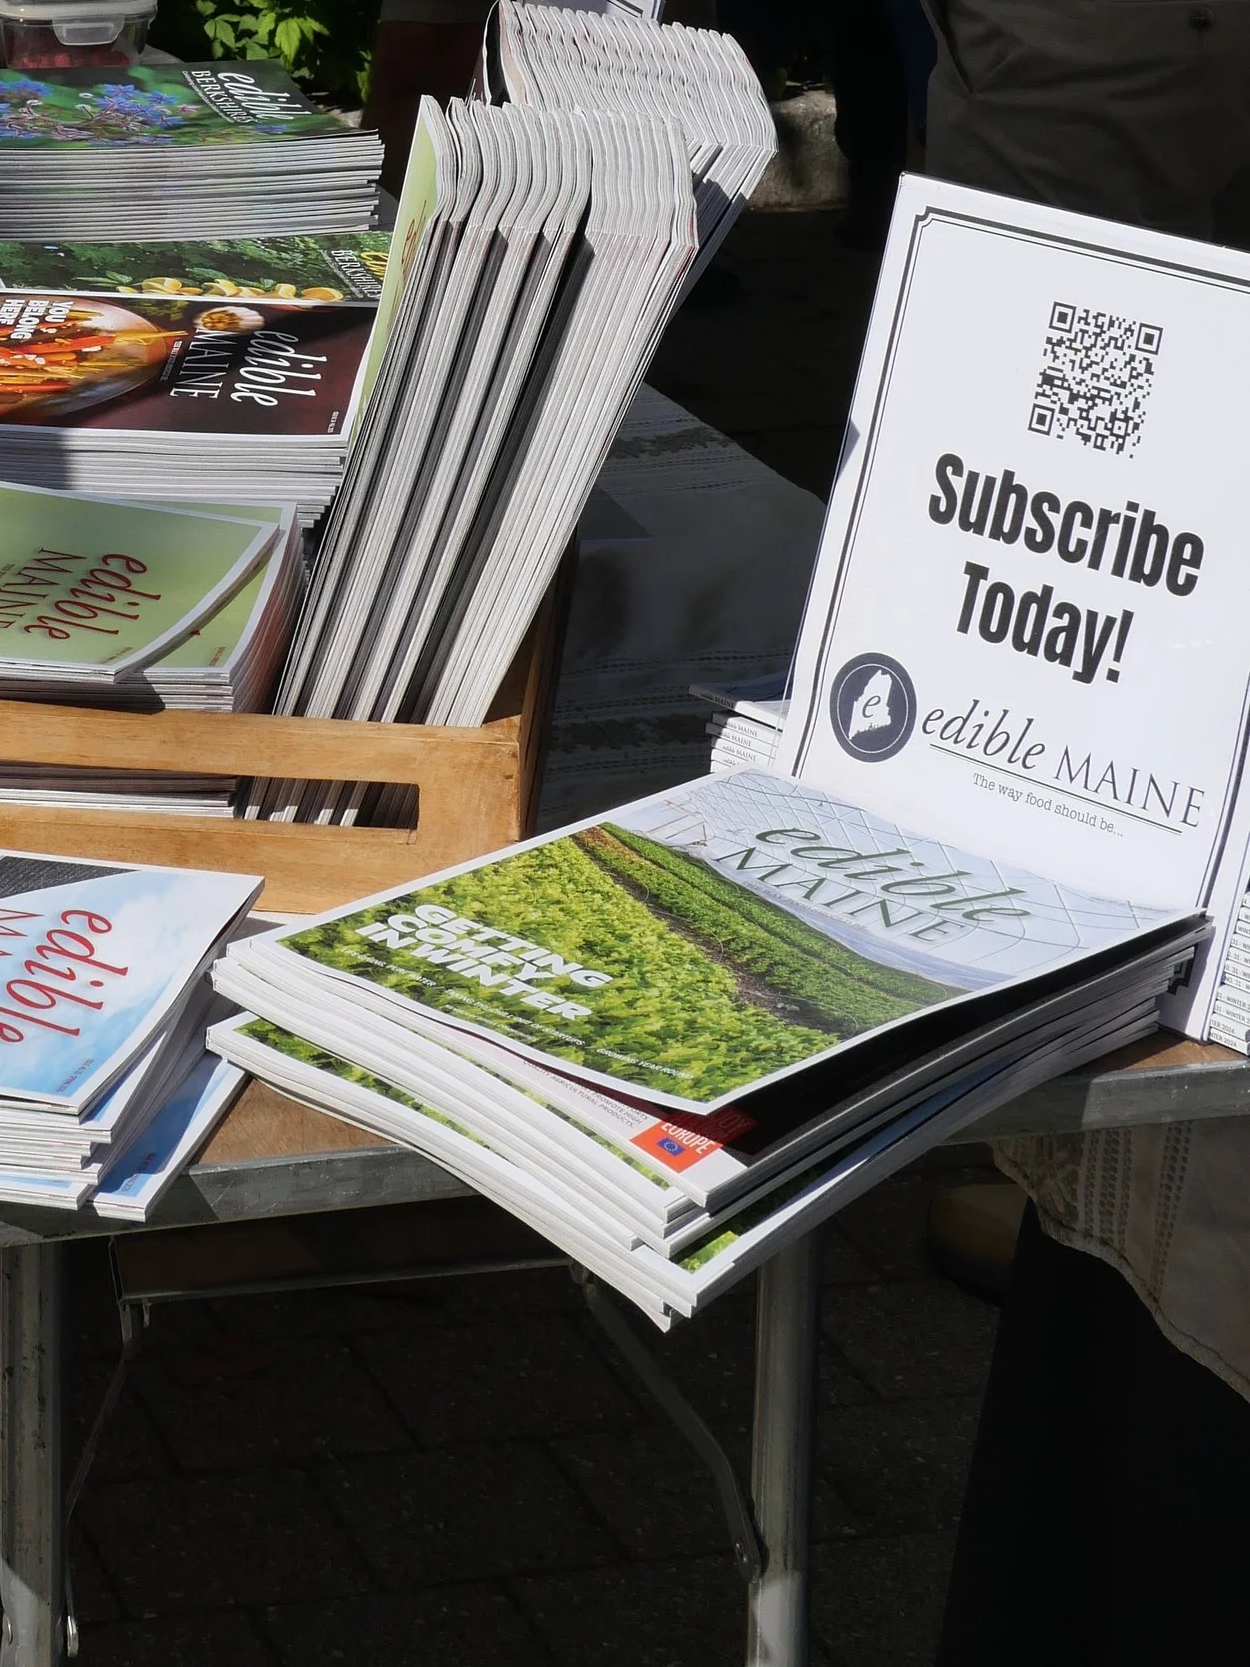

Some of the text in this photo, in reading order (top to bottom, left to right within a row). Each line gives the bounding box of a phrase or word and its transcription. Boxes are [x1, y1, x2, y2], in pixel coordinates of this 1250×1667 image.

[190, 70, 258, 125] BERKSHIRES
[217, 71, 312, 121] edible
[330, 249, 382, 300] BERKSHIRES
[9, 299, 49, 340] BELONG
[52, 300, 76, 323] YOU
[169, 328, 224, 400] MAINE
[230, 331, 328, 408] edible
[928, 453, 1205, 598] Subscribe
[23, 552, 162, 642] edible
[956, 561, 1134, 685] Today!
[715, 697, 735, 709] MAINE
[732, 735, 752, 747] MAINE
[736, 748, 757, 762] MAINE
[738, 725, 758, 737] MAINE
[922, 700, 1206, 828] edible MAINE
[972, 770, 996, 793] The
[996, 780, 1024, 803] way
[1026, 786, 1054, 812] food
[1056, 793, 1096, 825] should
[716, 845, 953, 944] MAINE
[754, 826, 1033, 924] edible
[386, 911, 559, 987] COMFY
[413, 902, 614, 990] GETTING
[355, 922, 595, 1023] IN WINTER
[1226, 1009, 1245, 1023] WINTER
[1227, 994, 1246, 1009] WINTER
[1222, 1023, 1235, 1034] 2024
[1224, 1036, 1237, 1048] 2024
[550, 1074, 599, 1108] AGRICULTURAL
[661, 1121, 717, 1155] EUROPE
